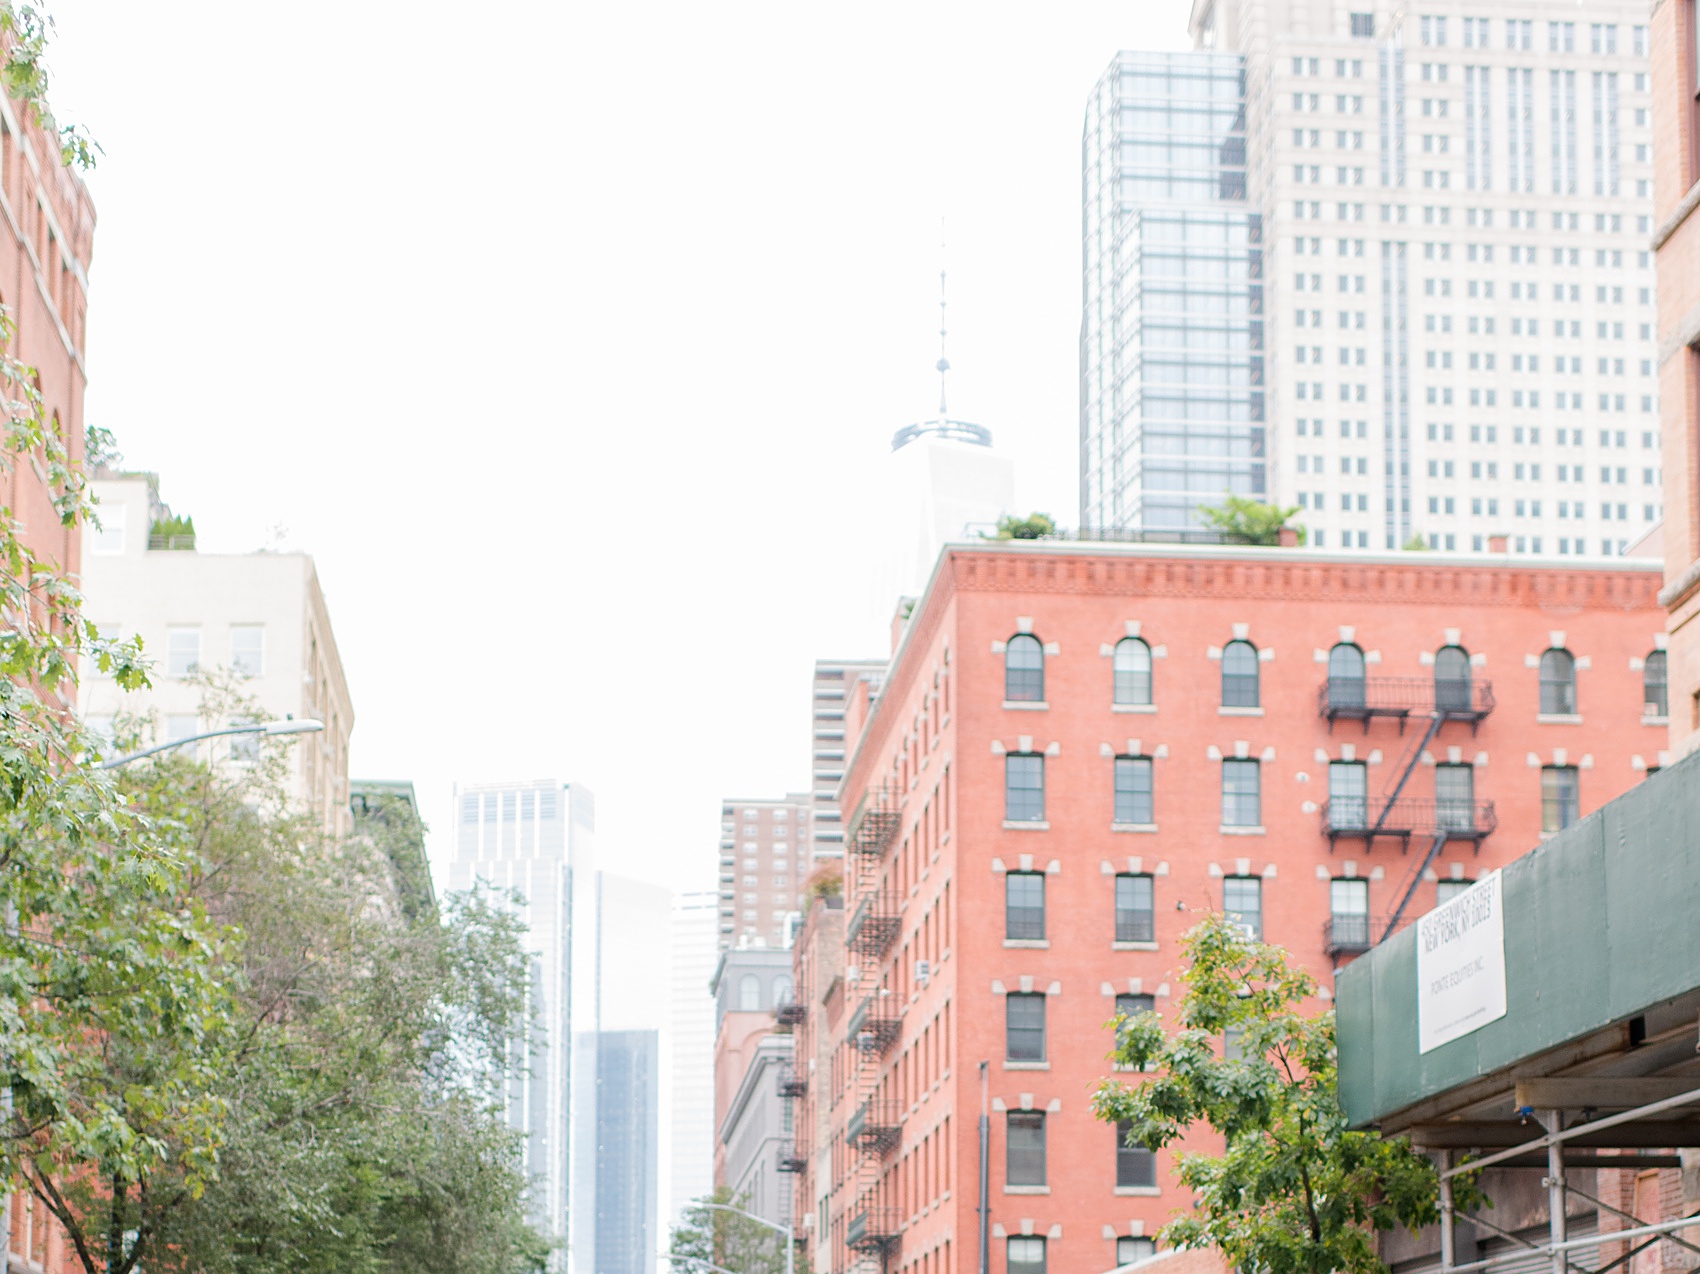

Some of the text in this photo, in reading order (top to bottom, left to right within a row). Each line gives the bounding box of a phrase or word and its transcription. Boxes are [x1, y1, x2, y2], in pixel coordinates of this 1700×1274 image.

[1425, 929, 1439, 953] NEW
[1462, 910, 1471, 934] NY
[1472, 897, 1491, 927] 10013
[1433, 893, 1470, 931] GREENWICH
[1471, 876, 1496, 907] STREET
[1449, 963, 1473, 987] EQUITIES
